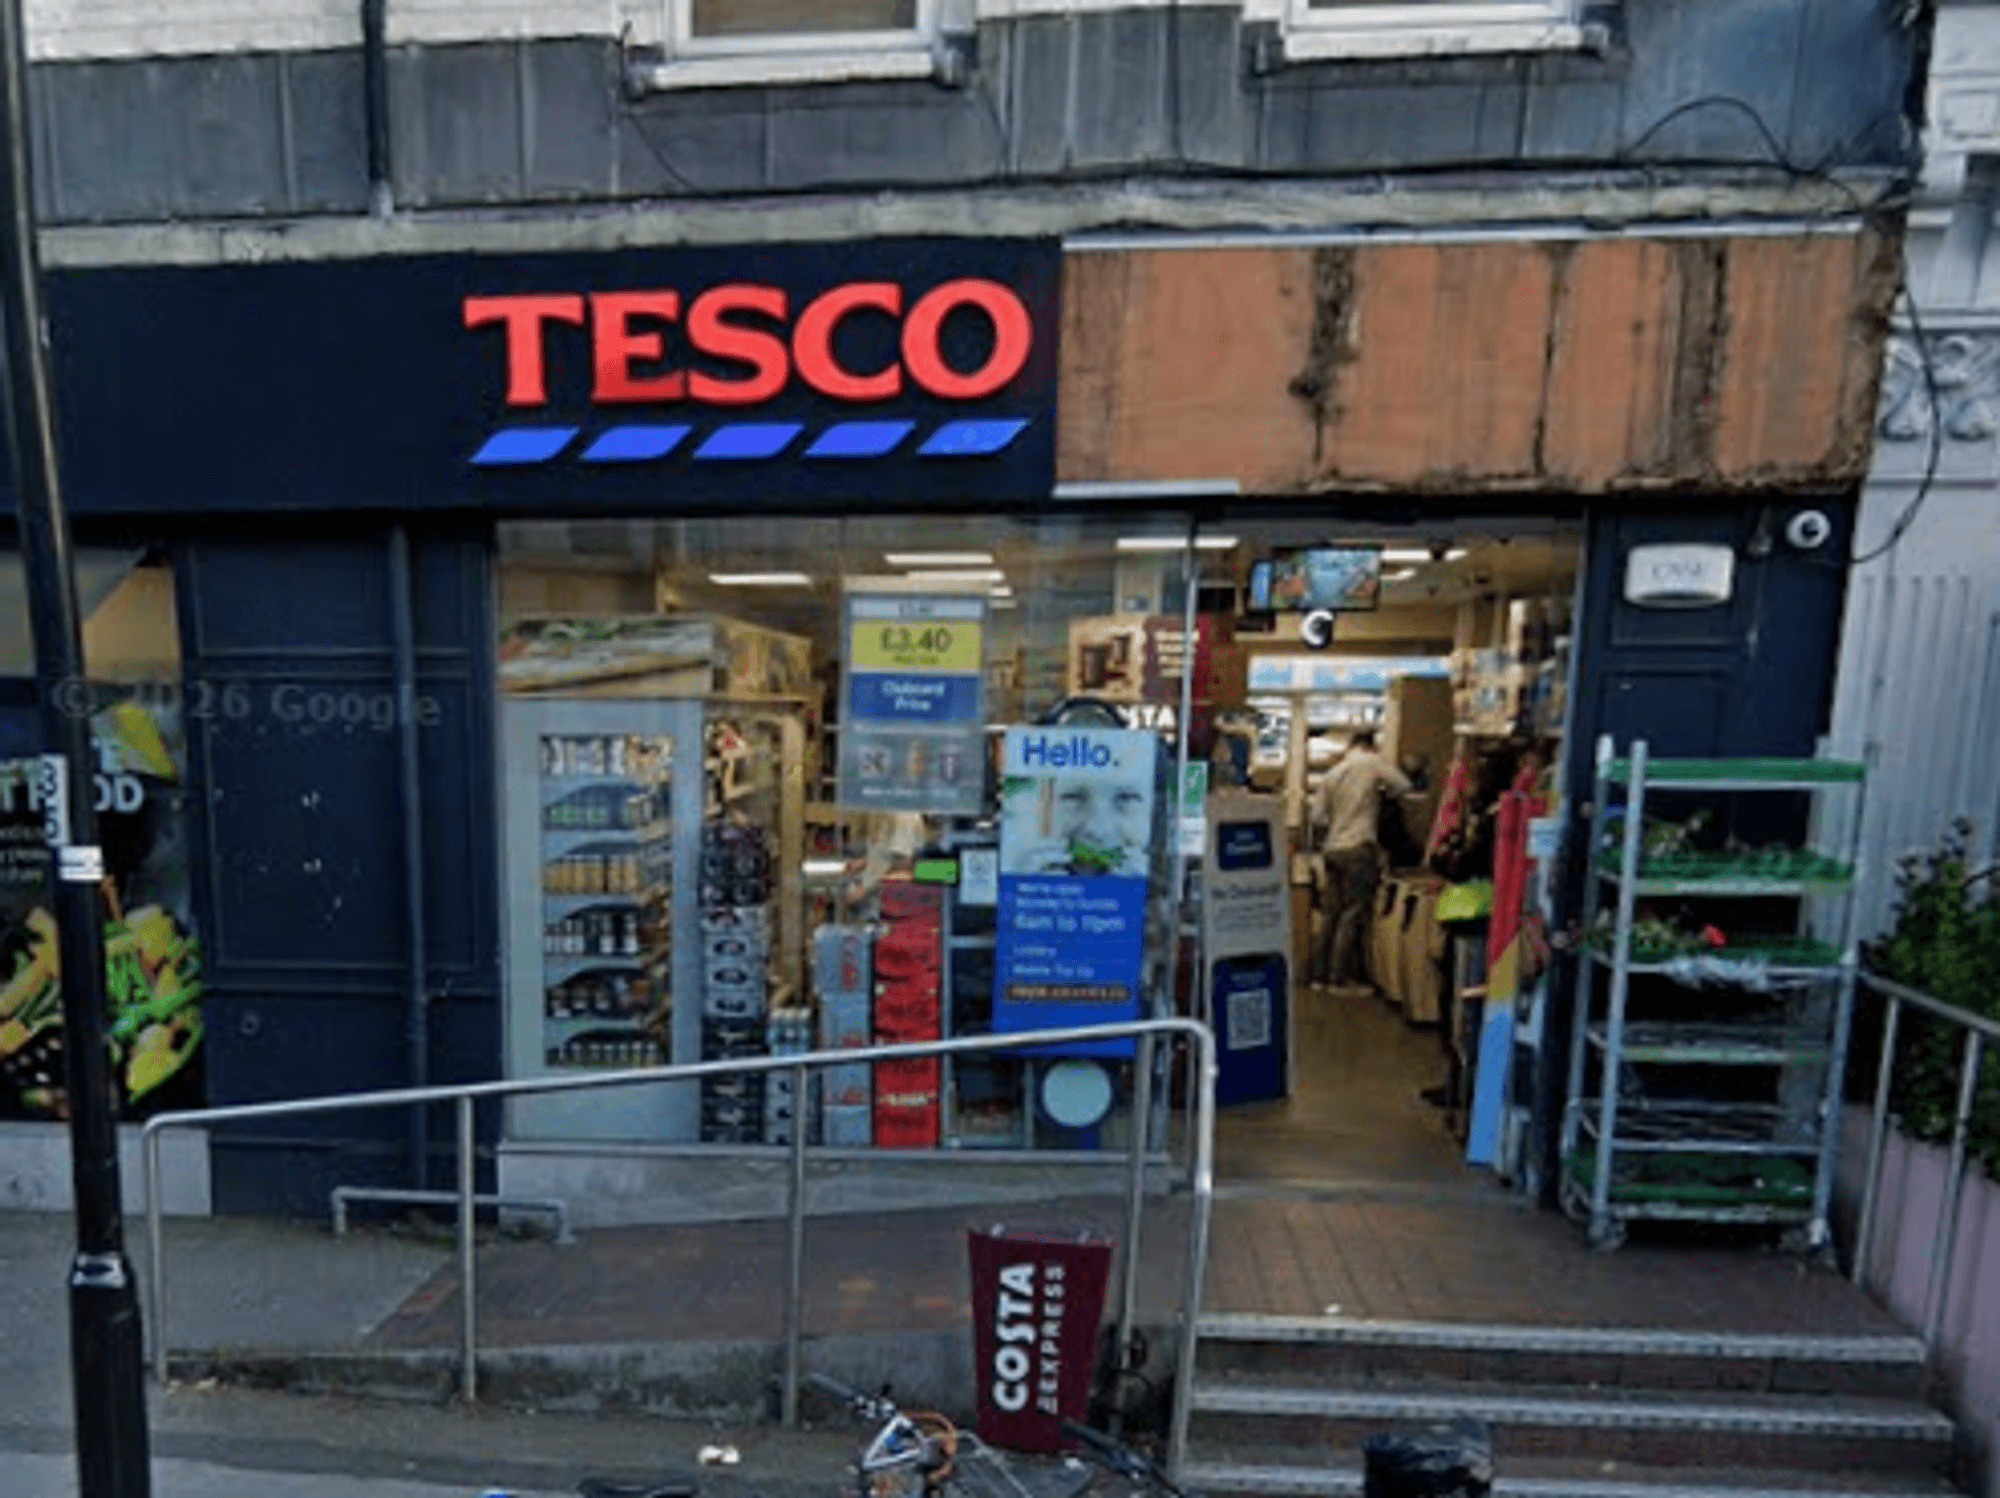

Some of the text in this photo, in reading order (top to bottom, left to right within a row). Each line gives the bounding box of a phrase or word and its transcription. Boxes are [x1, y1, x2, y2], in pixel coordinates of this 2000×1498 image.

[461, 277, 1034, 407] TESCO
[1022, 735, 1120, 767] Hello.
[992, 1262, 1037, 1411] COSTA
[1039, 1265, 1066, 1396] EXPRESS
